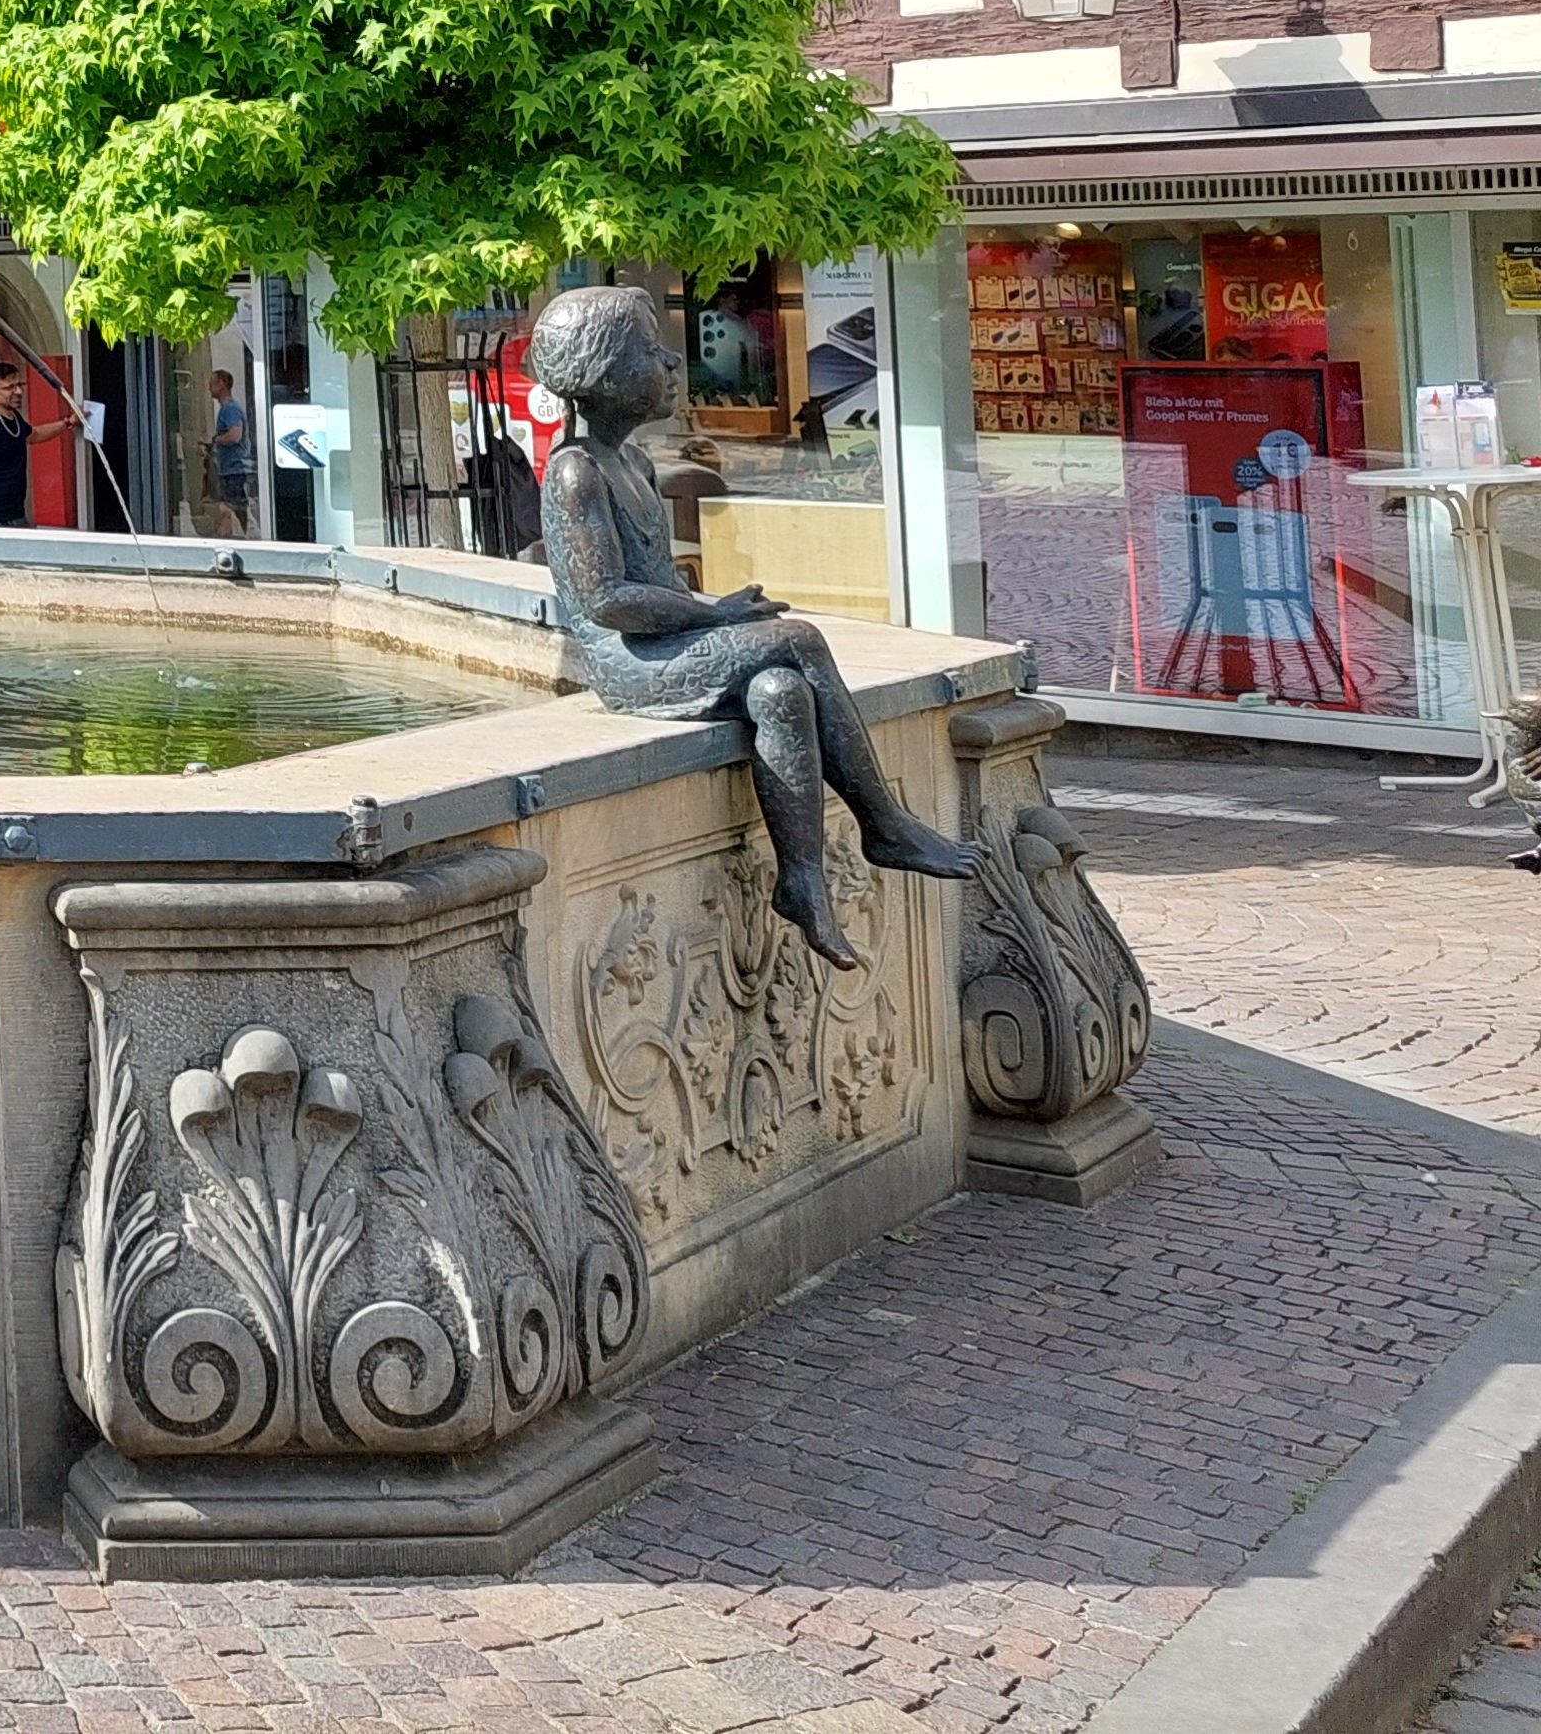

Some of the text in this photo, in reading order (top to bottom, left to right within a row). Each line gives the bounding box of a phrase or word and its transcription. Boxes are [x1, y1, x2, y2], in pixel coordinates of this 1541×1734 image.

[541, 388, 550, 403] 5
[1145, 397, 1224, 408] Bleib aktiv mit
[537, 405, 554, 417] GB
[1146, 410, 1269, 423] Google Pixel 7 Phones
[1237, 465, 1264, 476] 20%
